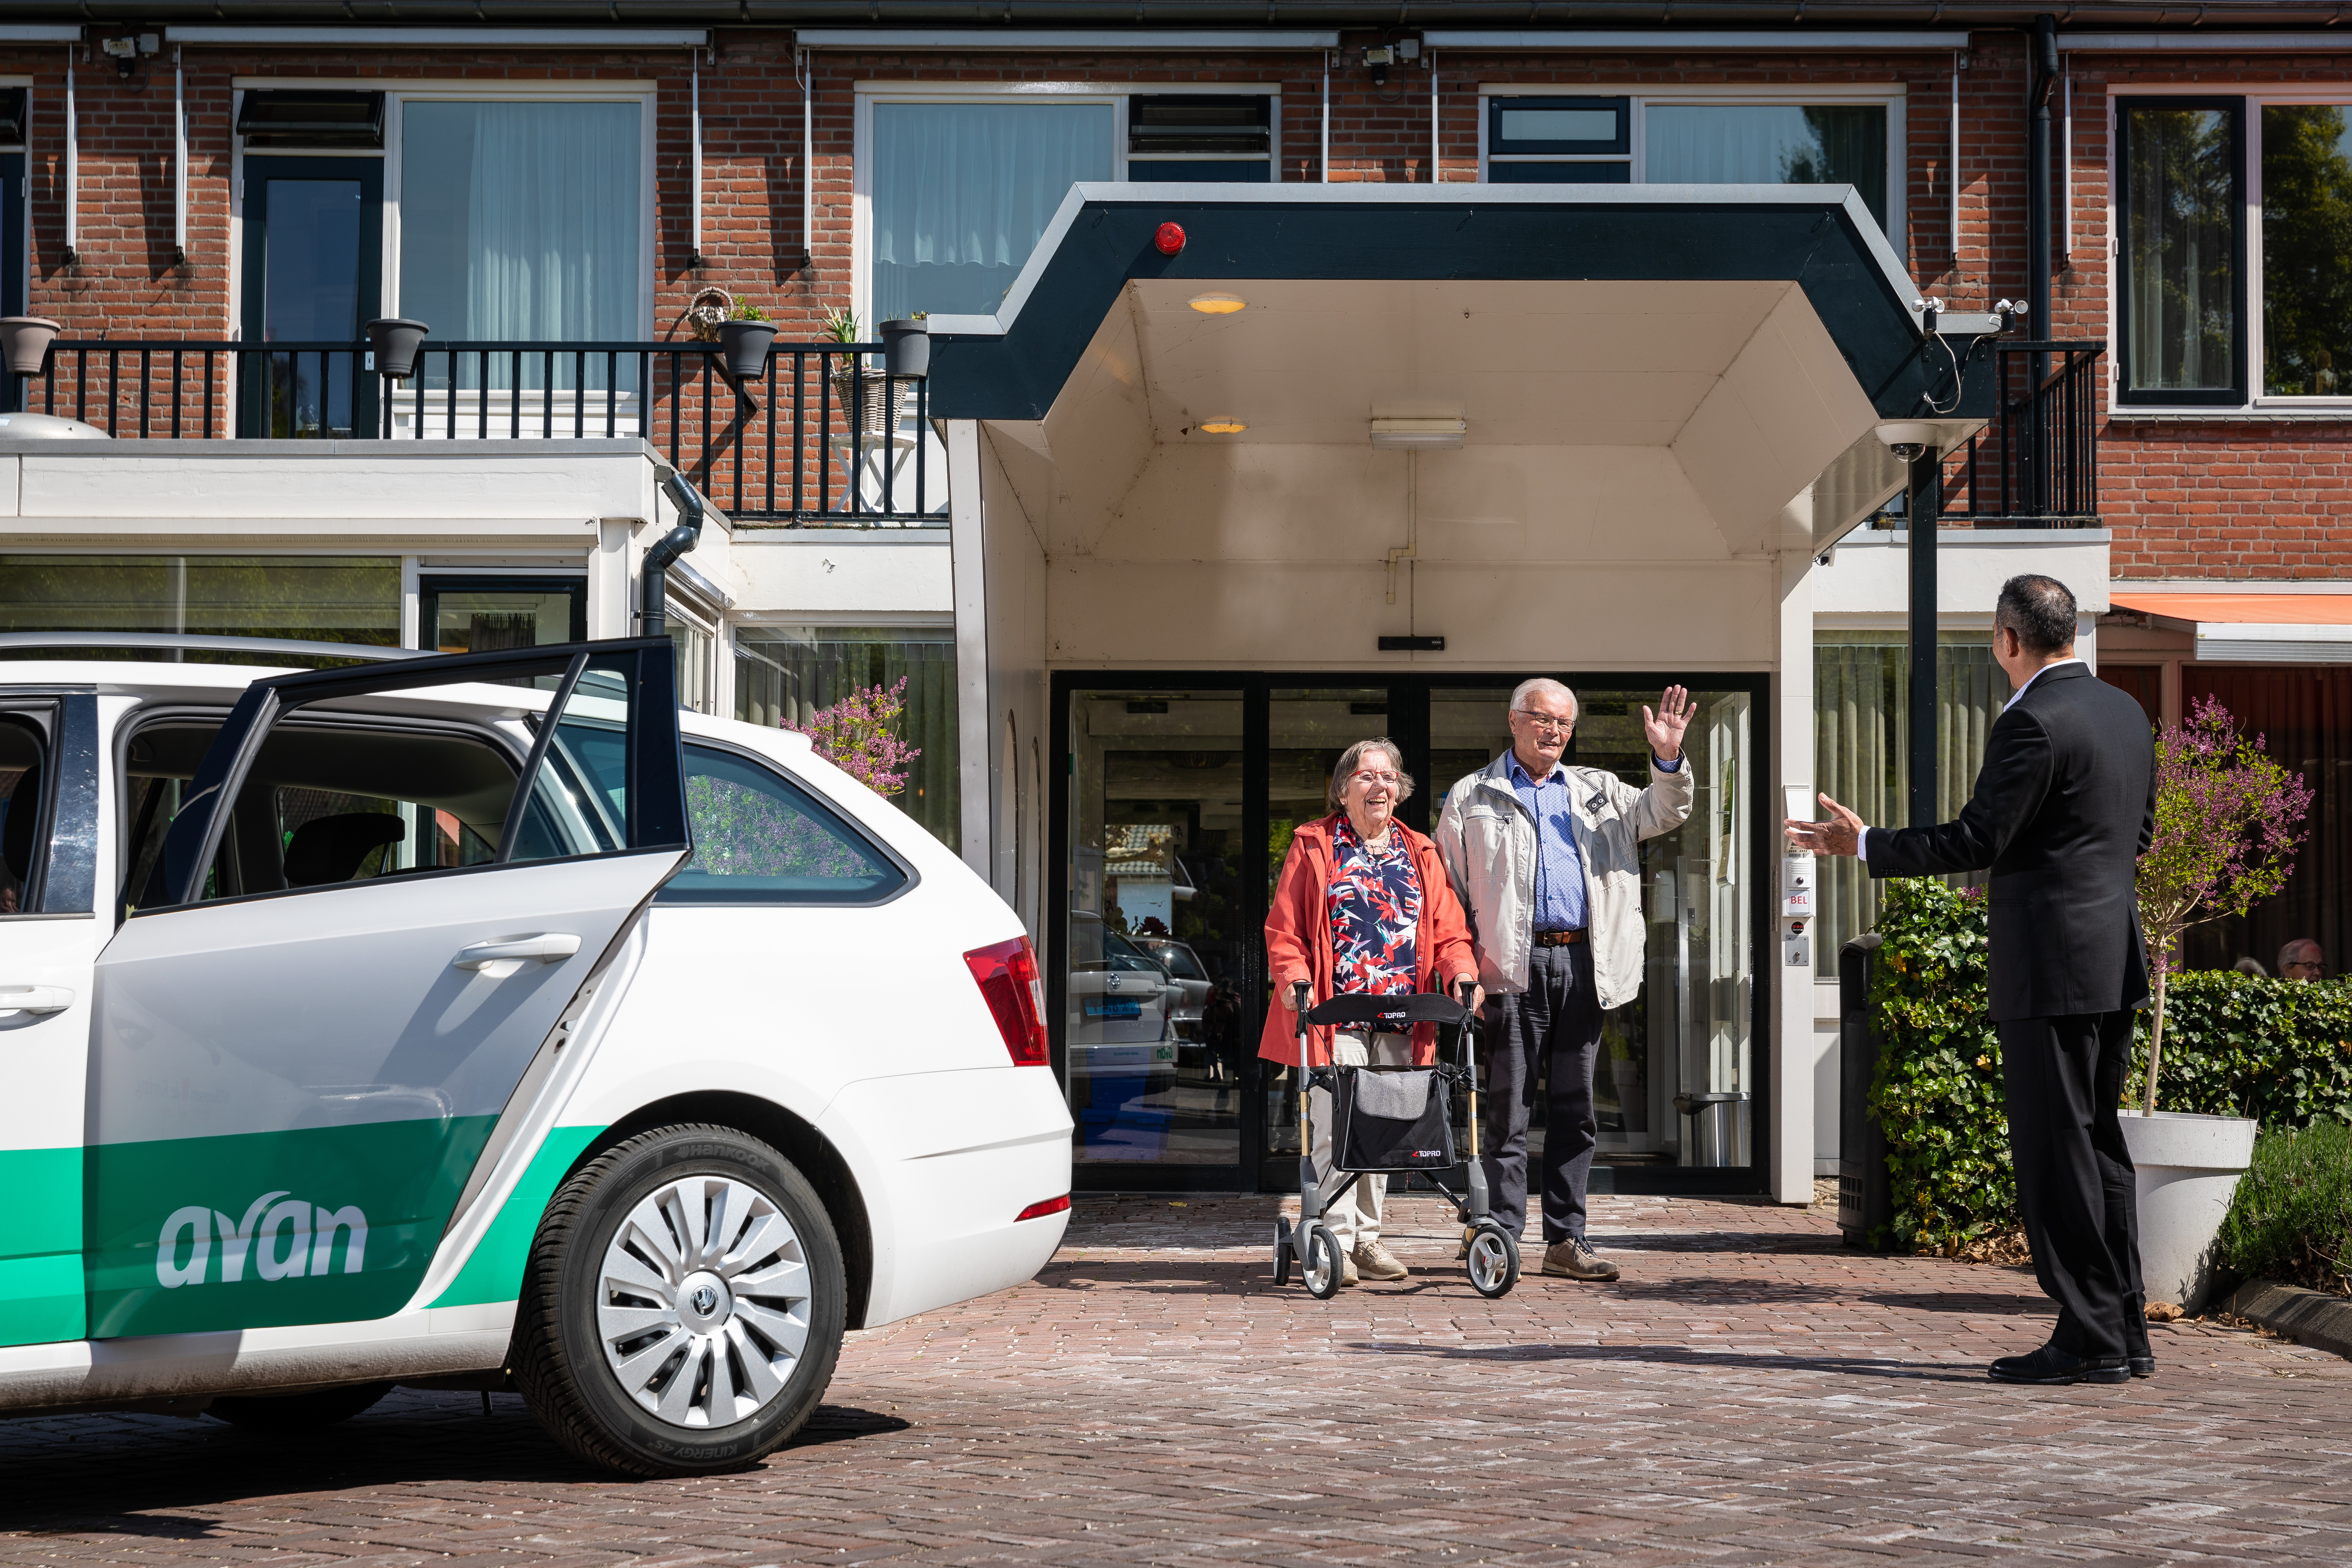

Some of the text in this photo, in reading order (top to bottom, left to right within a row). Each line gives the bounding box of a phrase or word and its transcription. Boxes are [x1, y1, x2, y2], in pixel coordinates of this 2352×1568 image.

[616, 1171, 635, 1189] Kontrol
[802, 1200, 818, 1225] Rotation
[156, 1190, 369, 1288] avan
[673, 1442, 739, 1460] KINERGY
